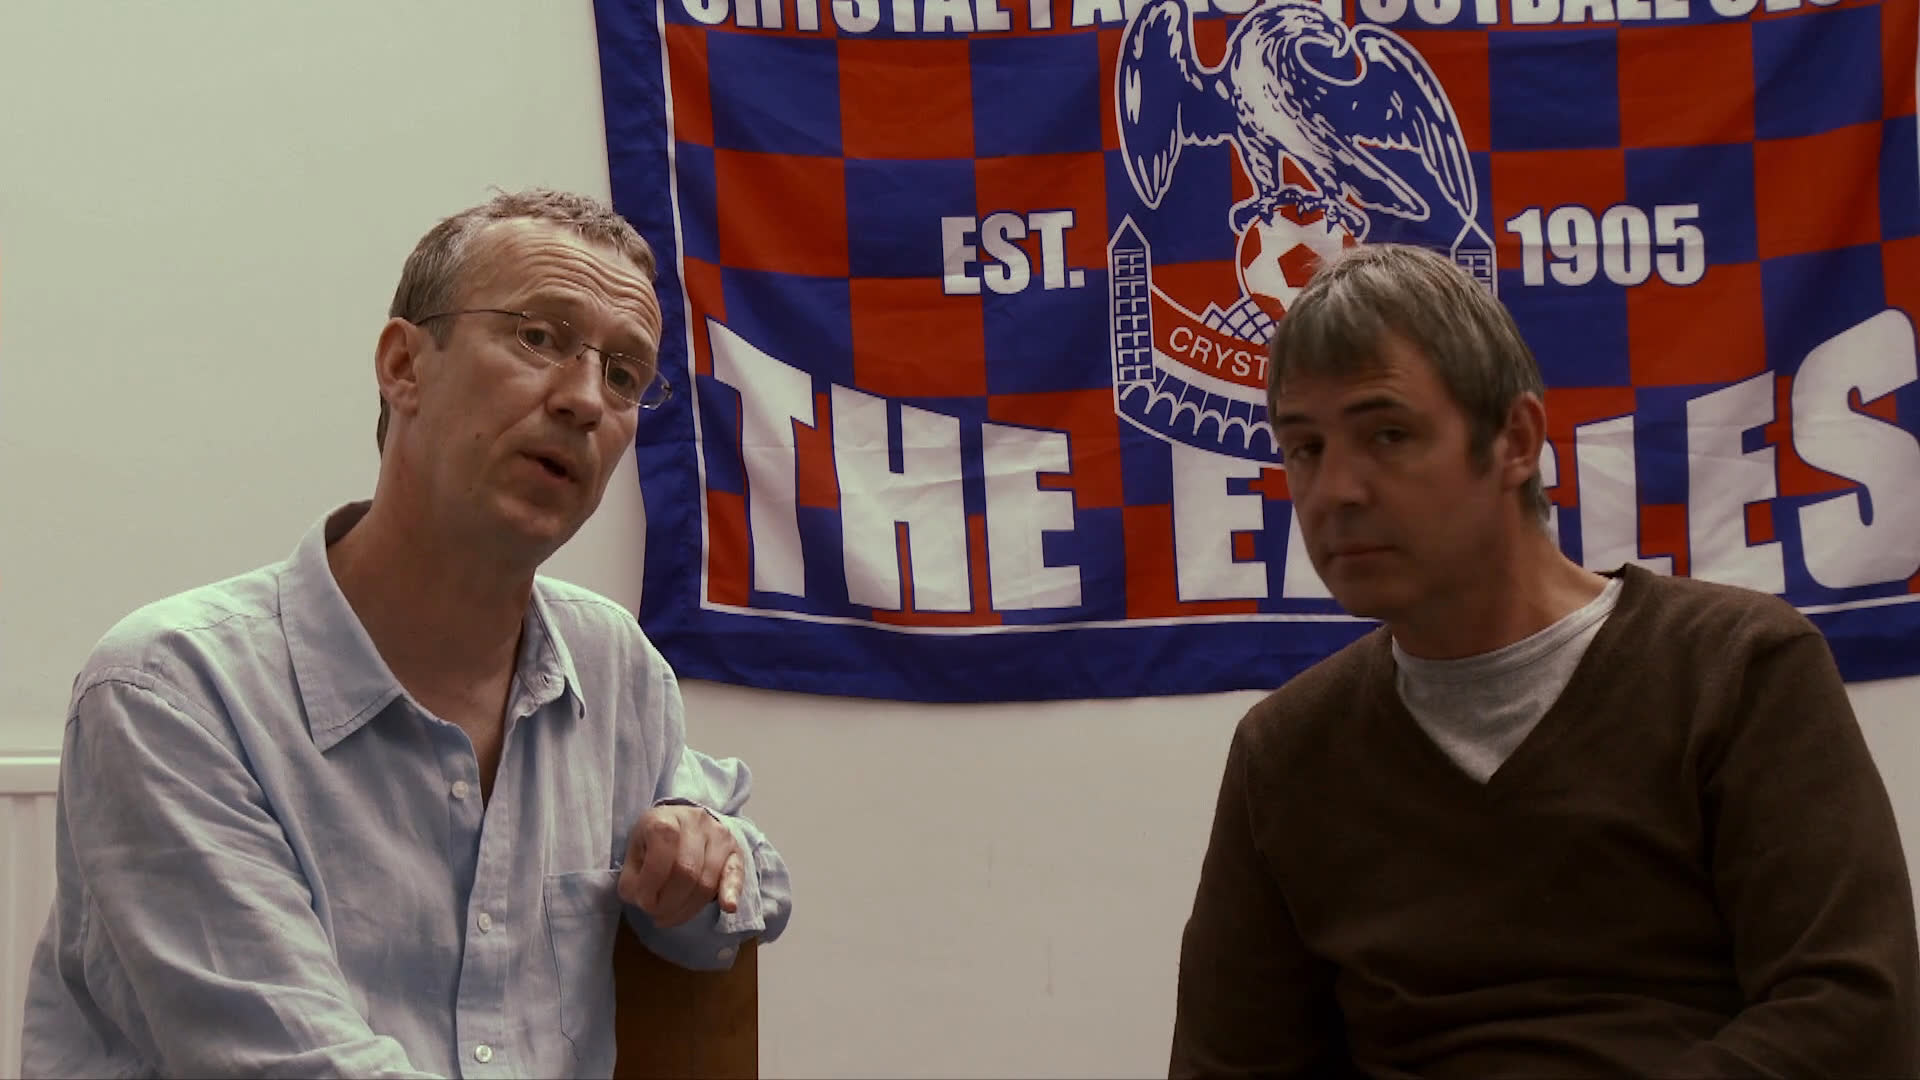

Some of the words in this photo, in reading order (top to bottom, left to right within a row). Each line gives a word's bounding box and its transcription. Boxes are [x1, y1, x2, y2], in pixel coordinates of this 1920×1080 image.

[941, 210, 1085, 294] EST.
[1507, 204, 1705, 286] 1905
[1169, 326, 1269, 380] CRYST
[706, 316, 1082, 613] THE
[1171, 309, 1919, 601] ELES
